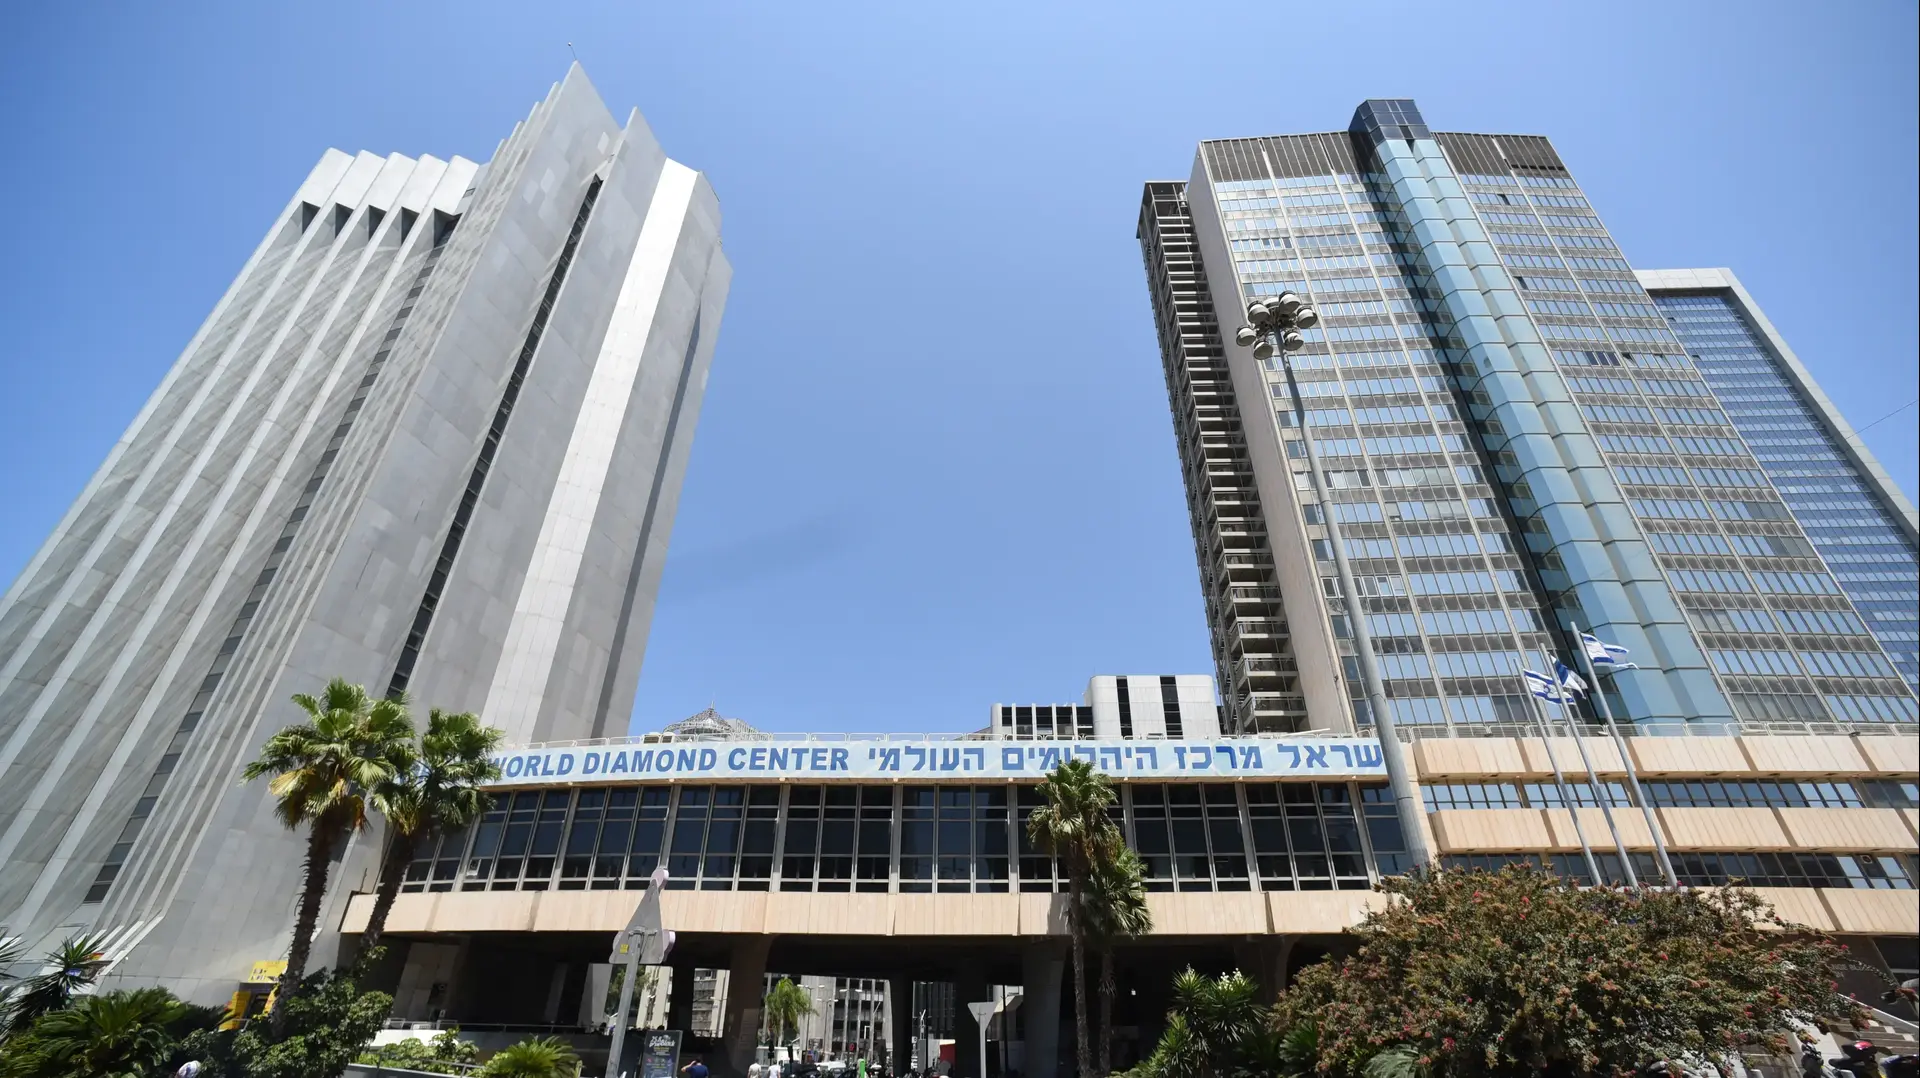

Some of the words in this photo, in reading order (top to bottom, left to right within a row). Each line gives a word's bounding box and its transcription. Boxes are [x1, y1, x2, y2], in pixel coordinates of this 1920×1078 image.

[582, 748, 717, 774] DIAMOND
[728, 747, 849, 771] CENTER
[867, 745, 985, 772] העולמי
[1002, 745, 1158, 770] היהלומים
[1174, 745, 1263, 770] מרכז
[1277, 743, 1384, 769] שראל
